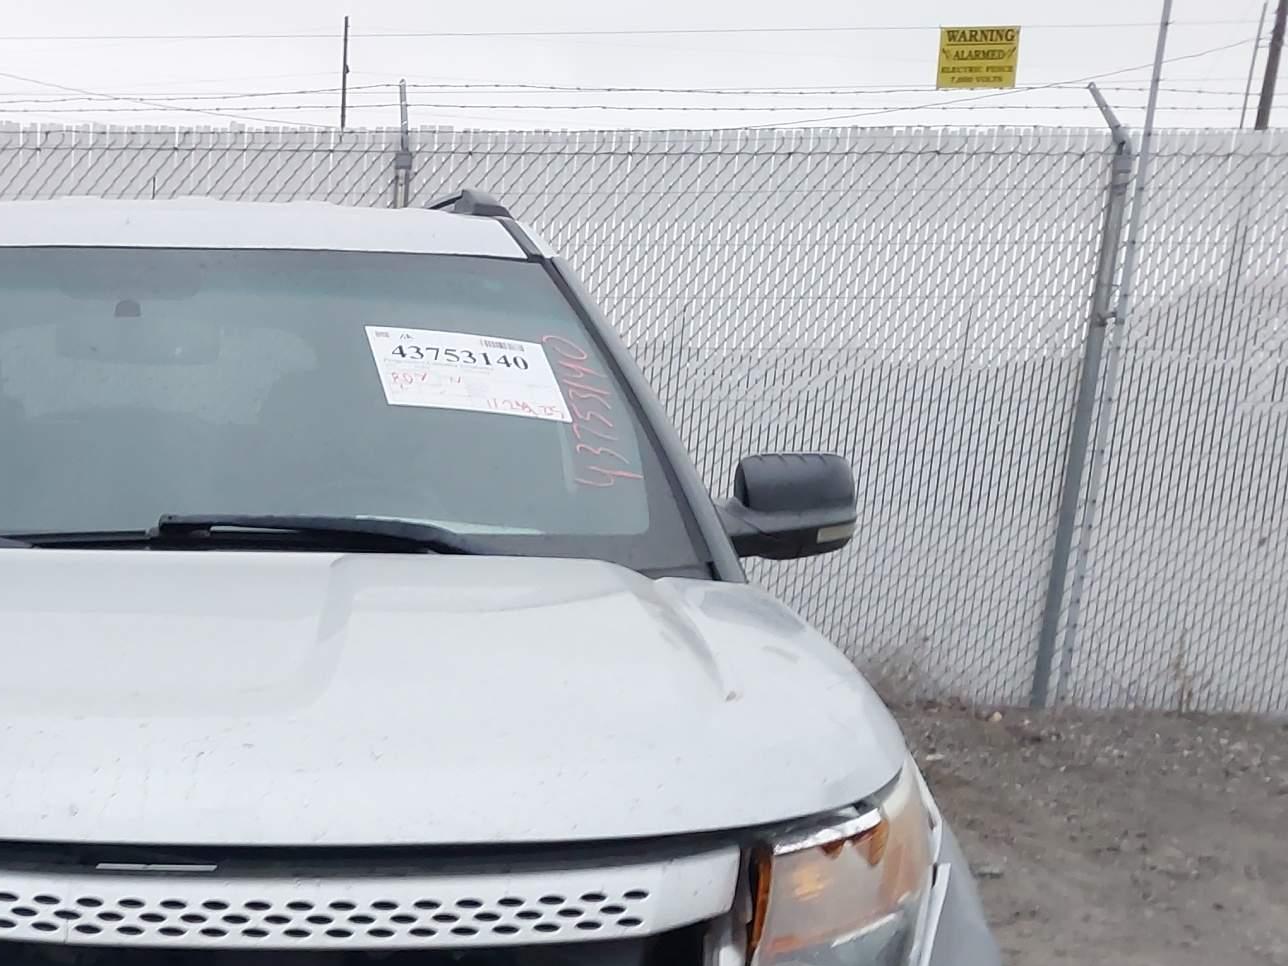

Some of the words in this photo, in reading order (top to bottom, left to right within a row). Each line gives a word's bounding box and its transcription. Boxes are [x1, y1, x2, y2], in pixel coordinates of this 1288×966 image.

[946, 29, 1015, 42] WARNING
[953, 49, 1005, 61] ALARMED
[391, 344, 529, 371] 43753140
[543, 335, 644, 487] 43753140
